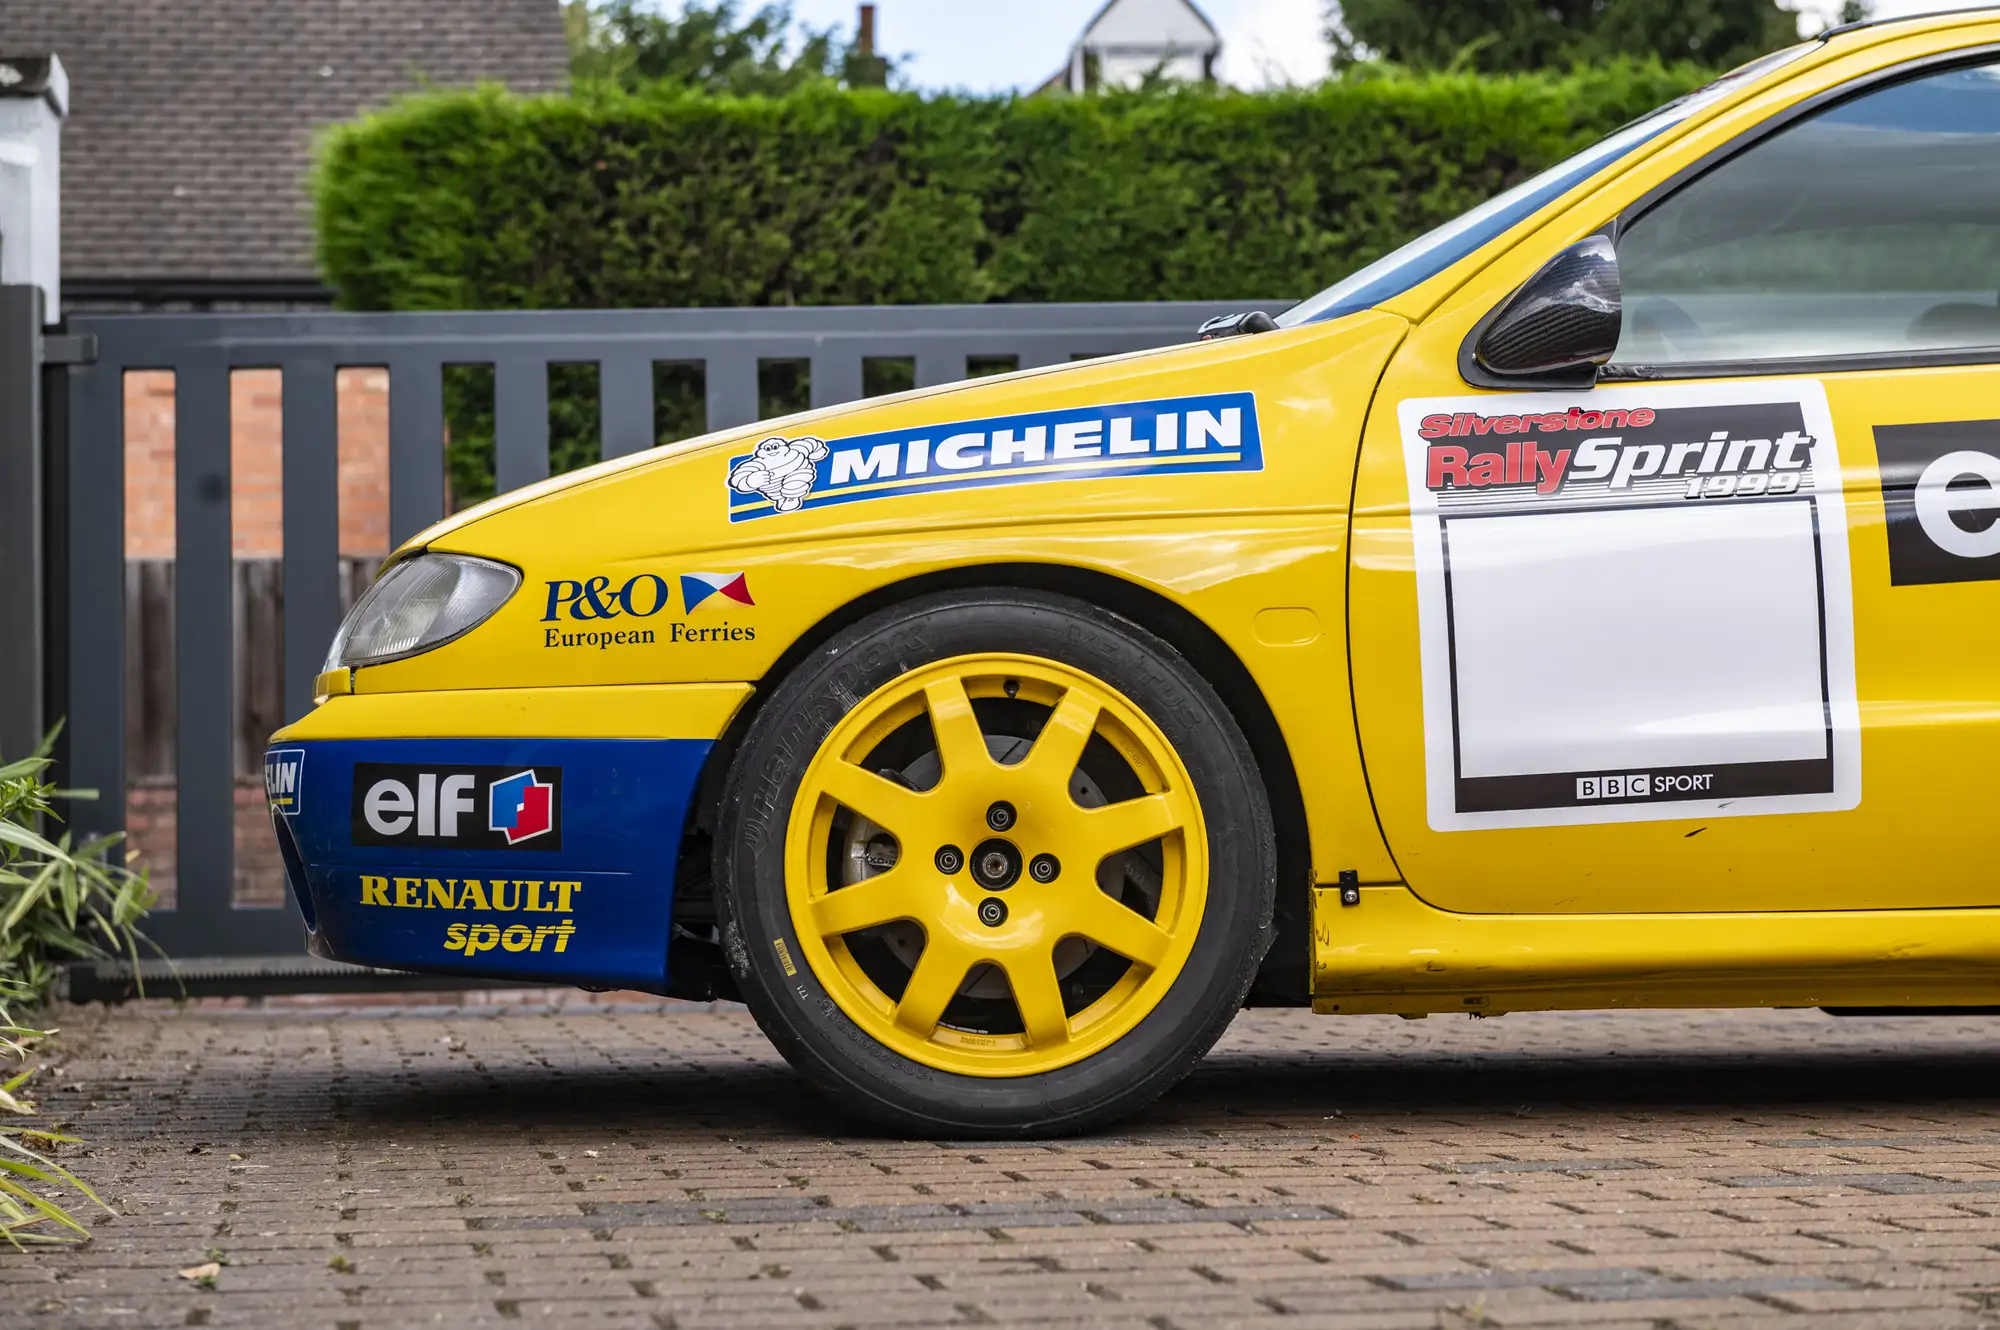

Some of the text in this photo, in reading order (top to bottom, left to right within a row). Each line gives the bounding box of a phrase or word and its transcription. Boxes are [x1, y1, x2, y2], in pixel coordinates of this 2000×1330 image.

[1419, 407, 1656, 439] Silverstone
[830, 407, 1242, 485] MICHELIN
[1684, 471, 1803, 499] 1999
[540, 573, 669, 621] P&O
[544, 621, 756, 649] European Ferries
[363, 773, 476, 837] elf
[1576, 773, 1714, 800] BBC SPORT
[359, 875, 582, 912] RENAULT
[443, 919, 577, 956] sport
